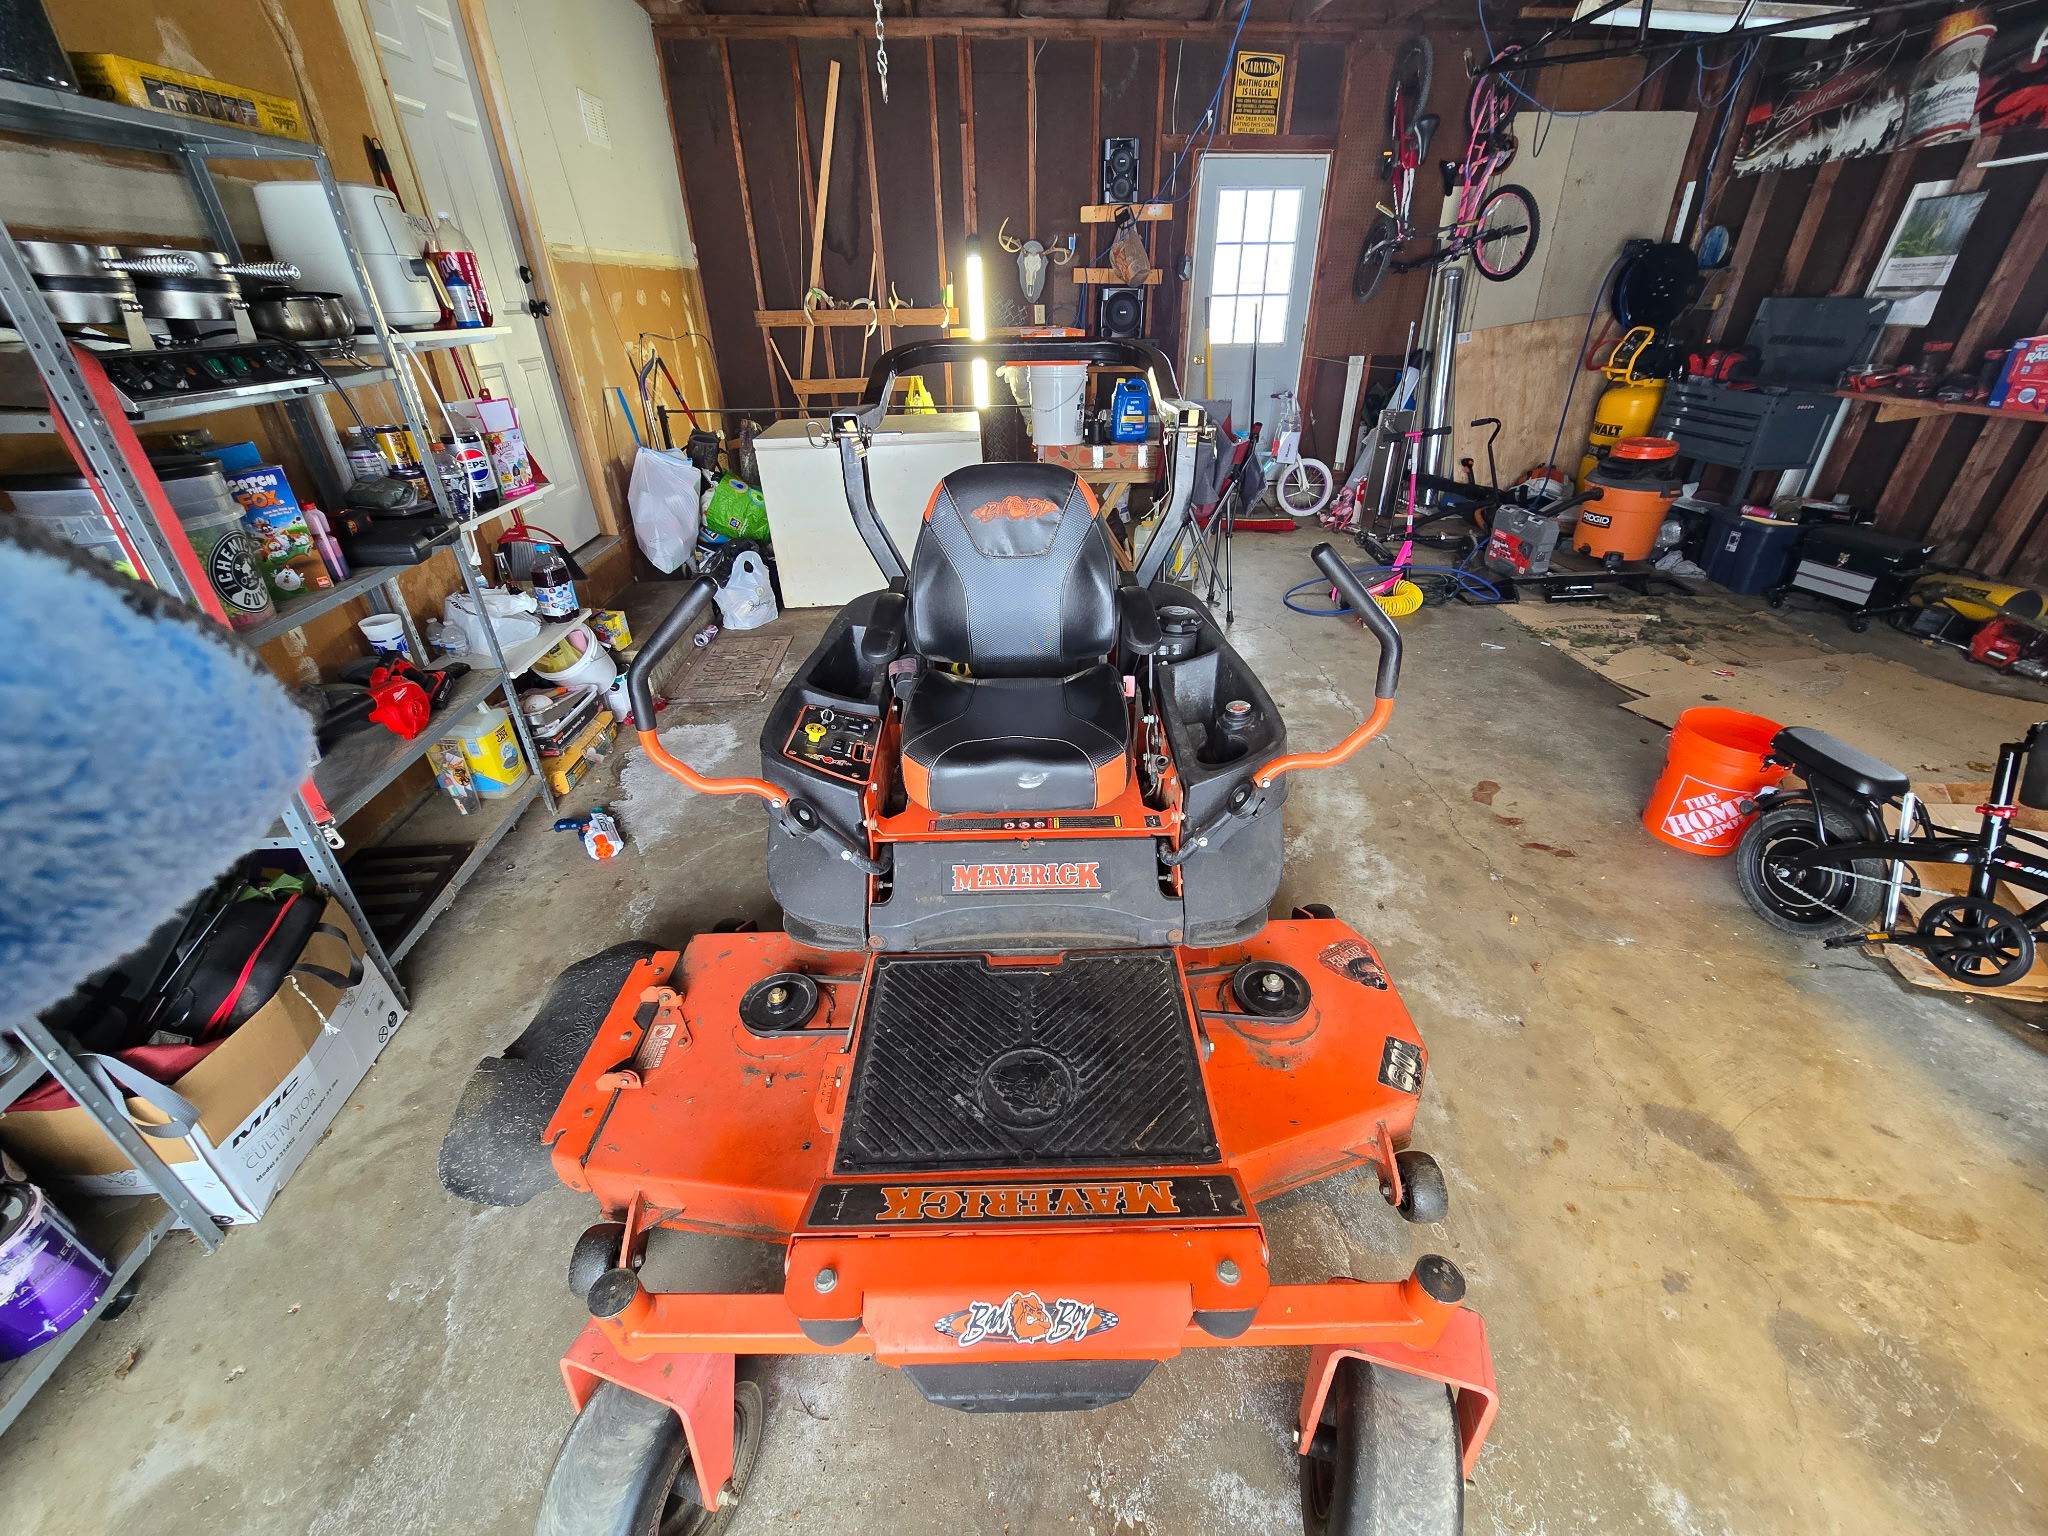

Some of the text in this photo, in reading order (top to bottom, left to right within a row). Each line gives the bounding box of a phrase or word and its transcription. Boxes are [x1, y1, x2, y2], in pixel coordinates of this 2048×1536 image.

[1243, 61, 1278, 74] WARNING
[1239, 79, 1279, 89] BAITING DEER
[1242, 88, 1272, 97] IS ILLEGAL
[1775, 67, 1882, 128] Budweiser
[1592, 423, 1623, 438] WALT
[460, 460, 488, 469] PEPSI
[228, 474, 278, 493] CATCH
[246, 486, 265, 495] THE
[237, 490, 283, 511] FOX
[1583, 511, 1611, 525] RIDGID
[1682, 793, 1722, 811] THE
[951, 862, 1102, 892] MAVERICK
[232, 1075, 299, 1149] MAC
[246, 1088, 316, 1169] CULTIVATOR
[256, 1161, 276, 1182] Model
[875, 1180, 1181, 1221] MAVERICK
[959, 1298, 1095, 1347] Bad Boy
